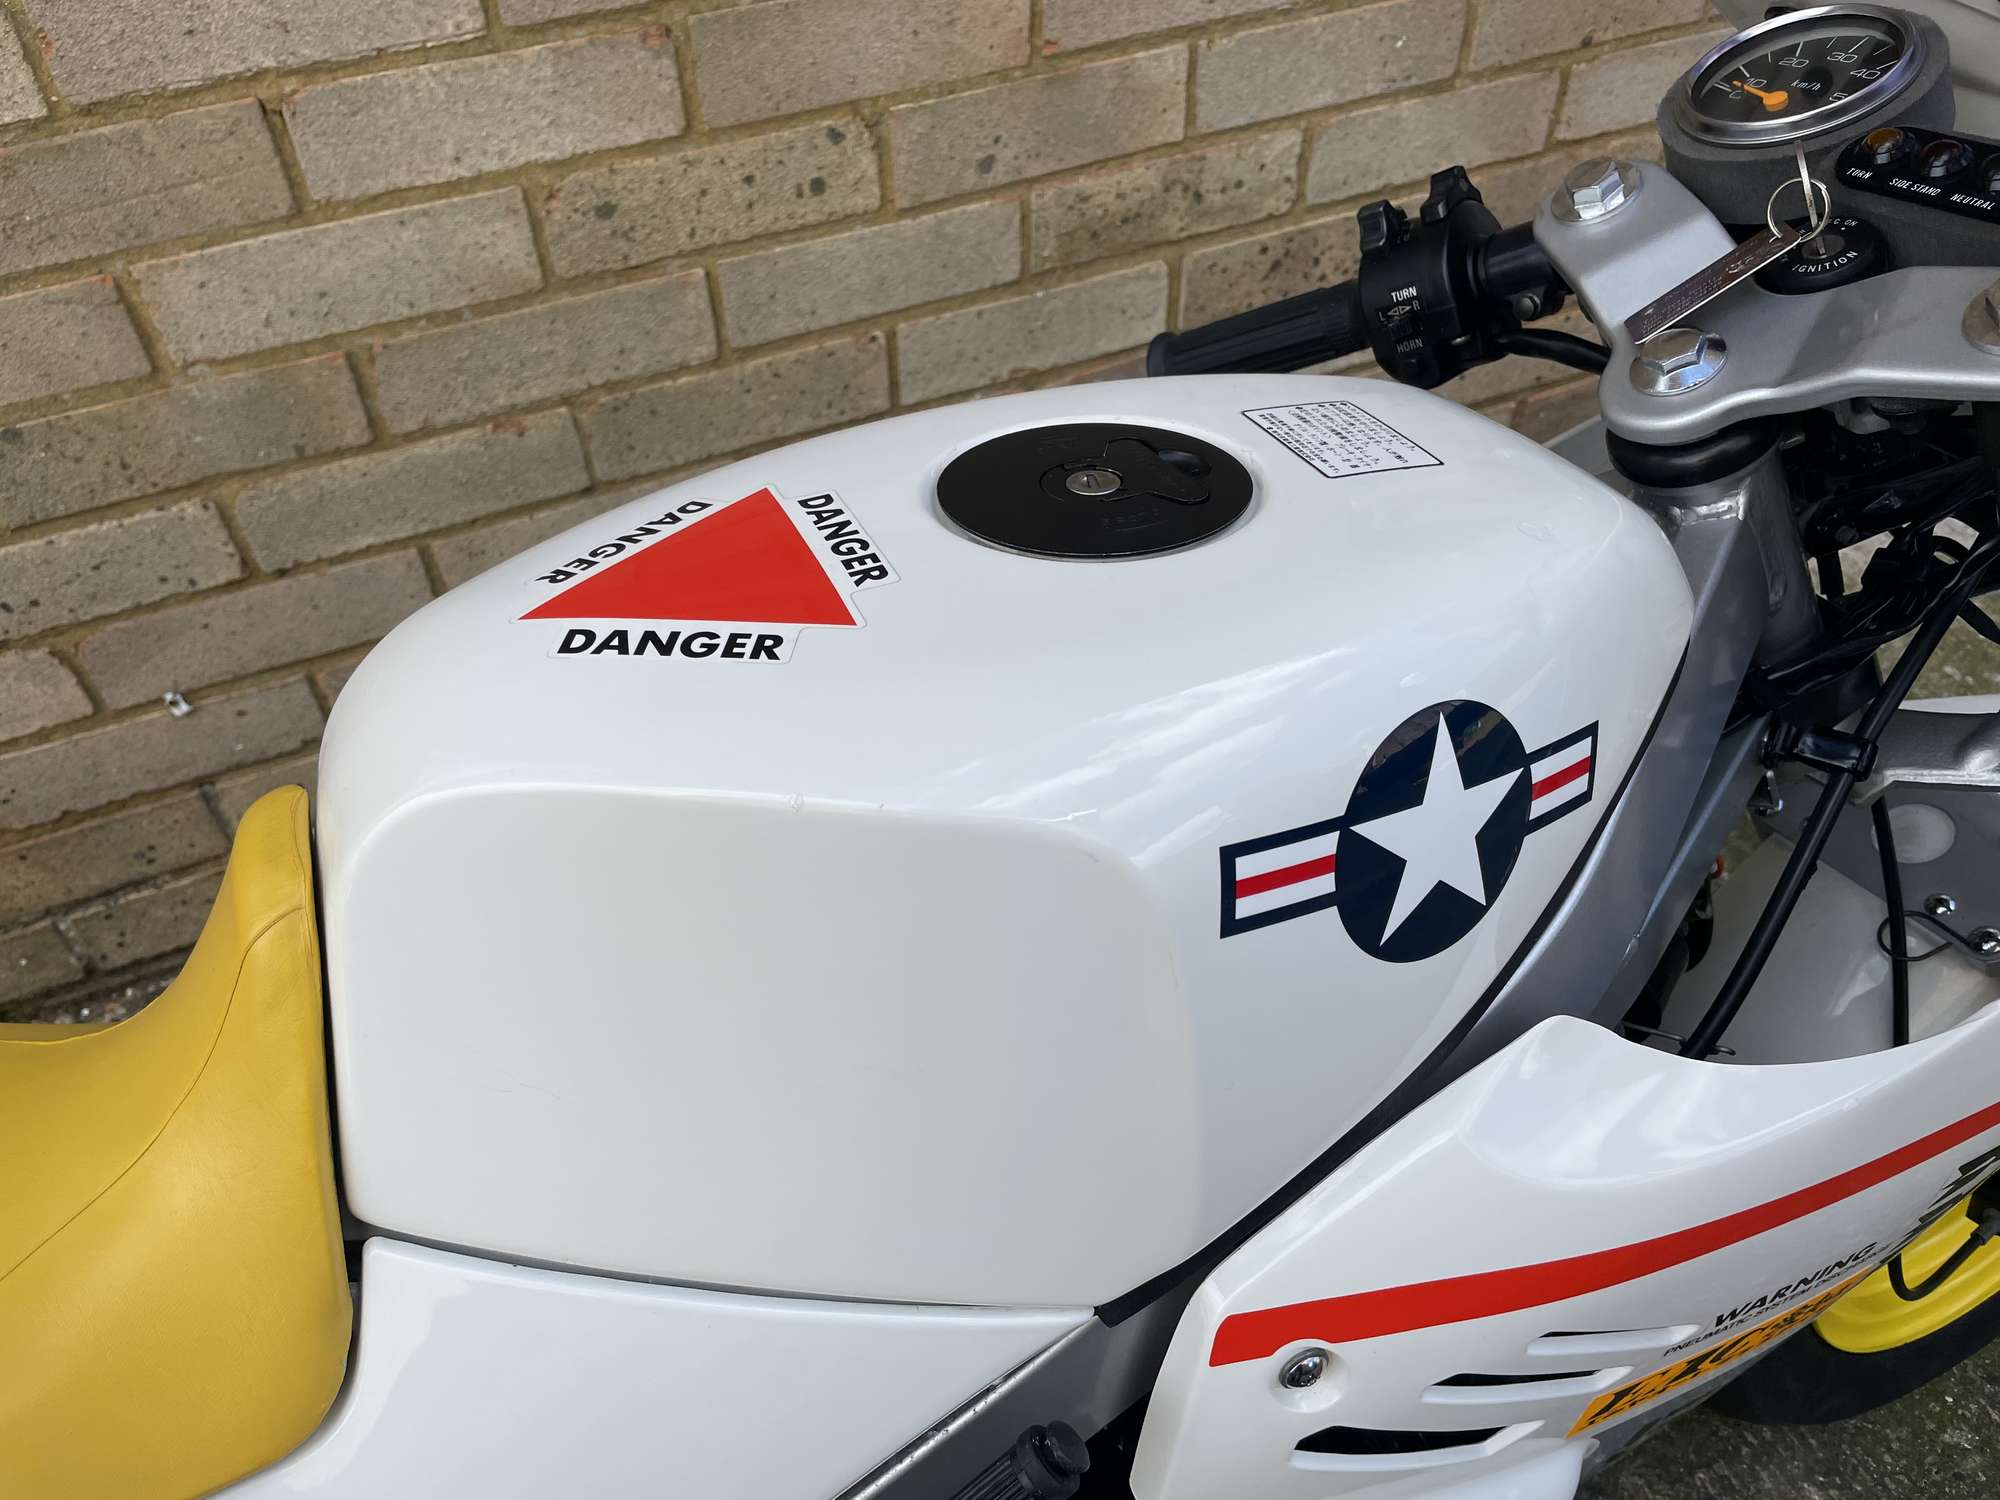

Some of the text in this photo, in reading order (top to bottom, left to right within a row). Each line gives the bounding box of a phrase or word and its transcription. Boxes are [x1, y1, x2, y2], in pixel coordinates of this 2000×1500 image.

[1778, 57, 1809, 68] 20
[1826, 51, 1858, 63] 30
[1850, 68, 1881, 80] 40
[1790, 79, 1822, 91] km/h
[1846, 167, 1873, 180] TURN
[1889, 178, 1941, 197] SIDE STAND
[1950, 193, 1996, 210] NEUTRAL
[1844, 219, 1858, 227] ON
[1792, 249, 1859, 273] IGNITION
[1391, 286, 1417, 303] TURN
[1412, 300, 1420, 311] R
[1396, 338, 1424, 353] HORN
[534, 500, 713, 585] DANGER
[797, 493, 889, 588] DANGER
[557, 628, 784, 661] DANGER
[1714, 1242, 1877, 1328] WARNING
